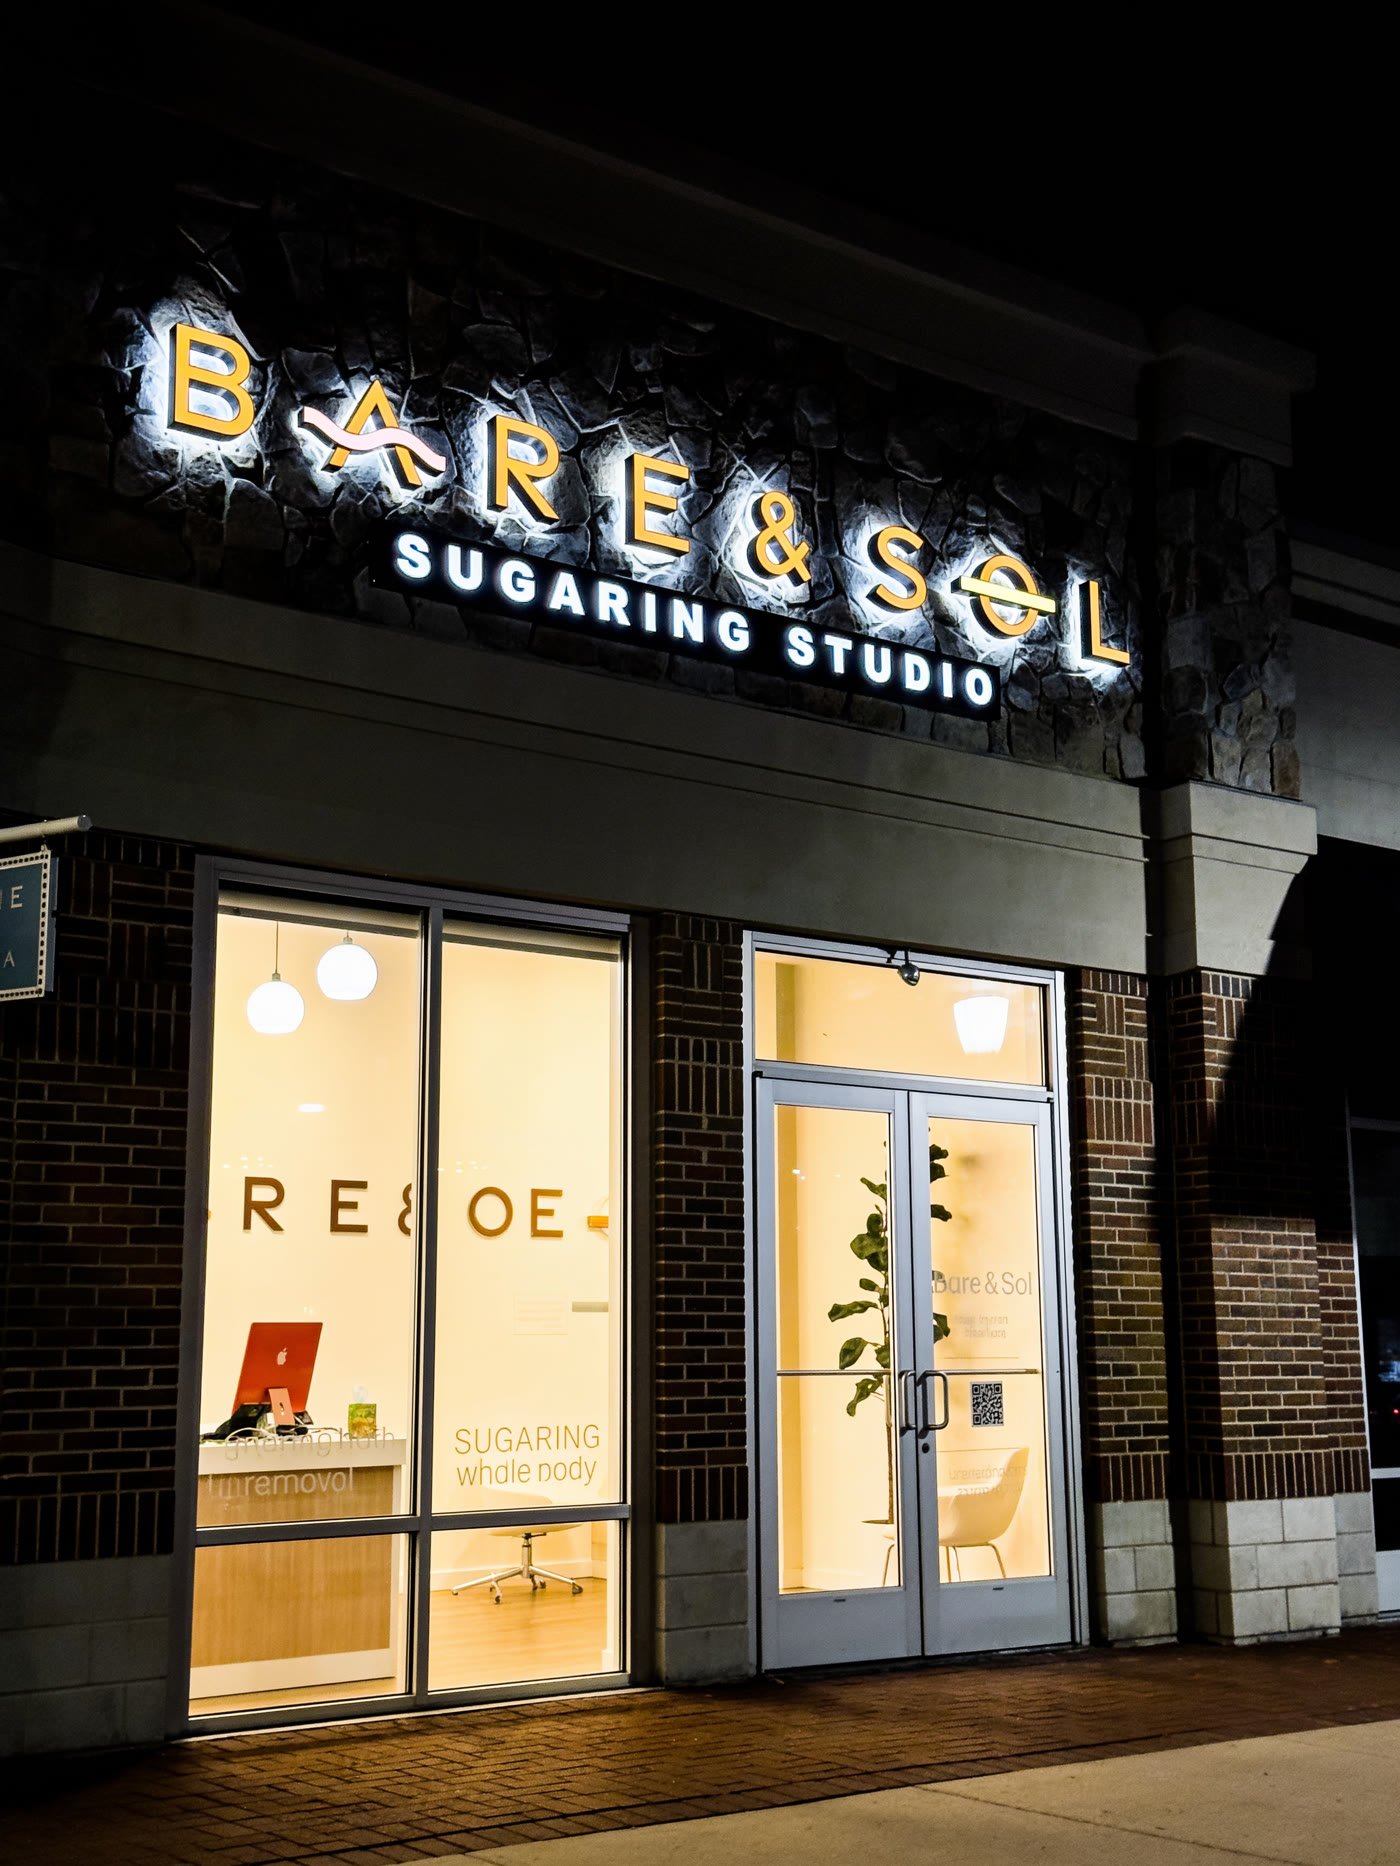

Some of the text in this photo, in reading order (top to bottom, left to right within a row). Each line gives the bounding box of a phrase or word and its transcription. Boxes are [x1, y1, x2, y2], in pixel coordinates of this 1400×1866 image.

[169, 322, 1131, 667] BARE & SOL
[397, 533, 994, 706] SUGARING STUDIO
[455, 1424, 600, 1455] SUGARING
